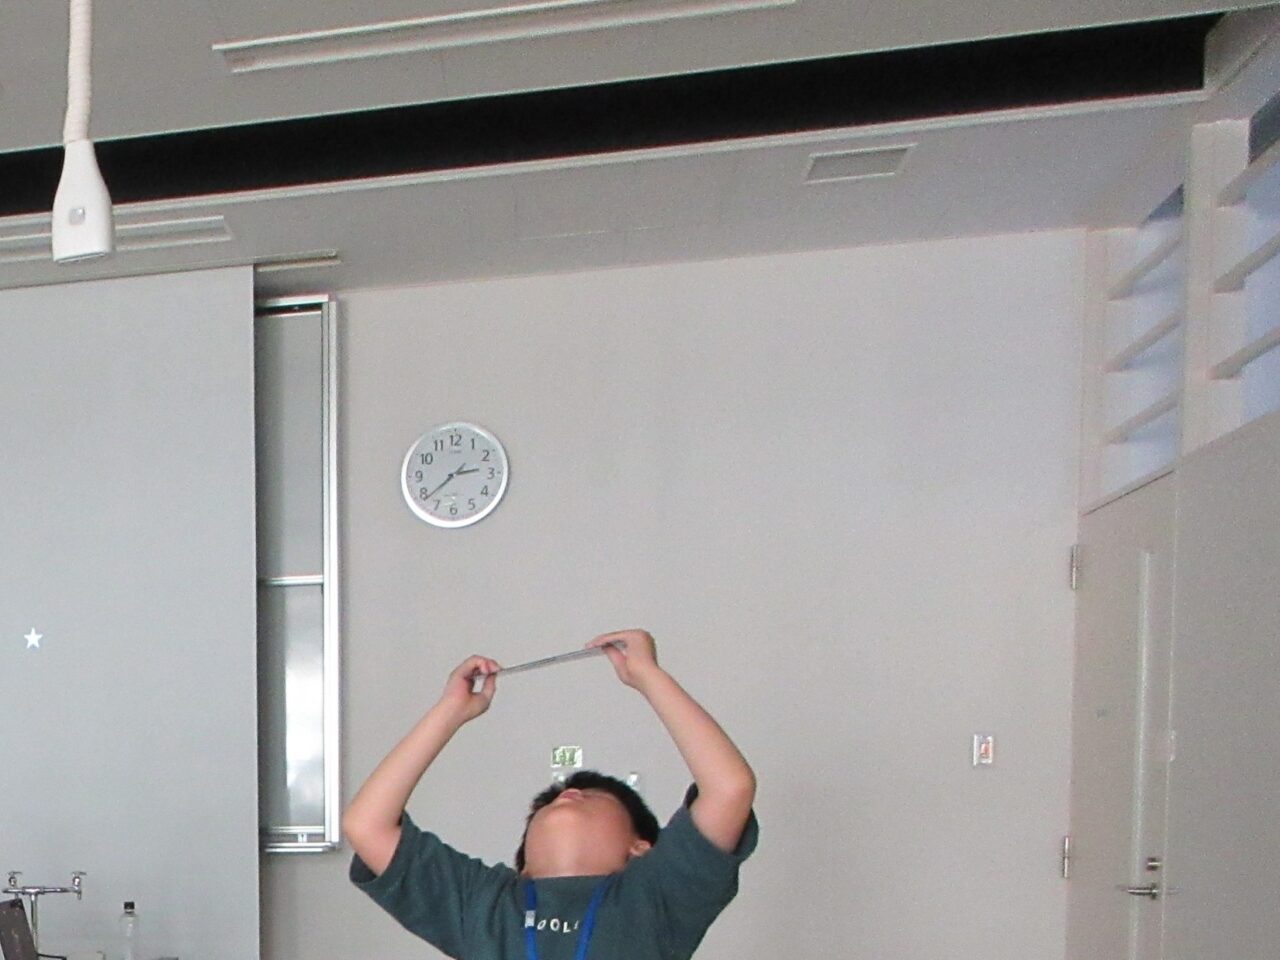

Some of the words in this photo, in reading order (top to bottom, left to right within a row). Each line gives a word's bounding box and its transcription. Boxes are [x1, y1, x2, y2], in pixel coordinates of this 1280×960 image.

[434, 440, 444, 451] 11
[449, 434, 462, 446] 12
[470, 438, 475, 449] 1
[421, 453, 433, 465] 10
[481, 450, 490, 461] 2
[415, 471, 423, 482] 9
[487, 468, 495, 479] 3
[420, 488, 428, 500] 8
[480, 485, 489, 496] 4
[433, 500, 440, 511] 7
[449, 503, 458, 515] 6
[468, 499, 476, 510] 5
